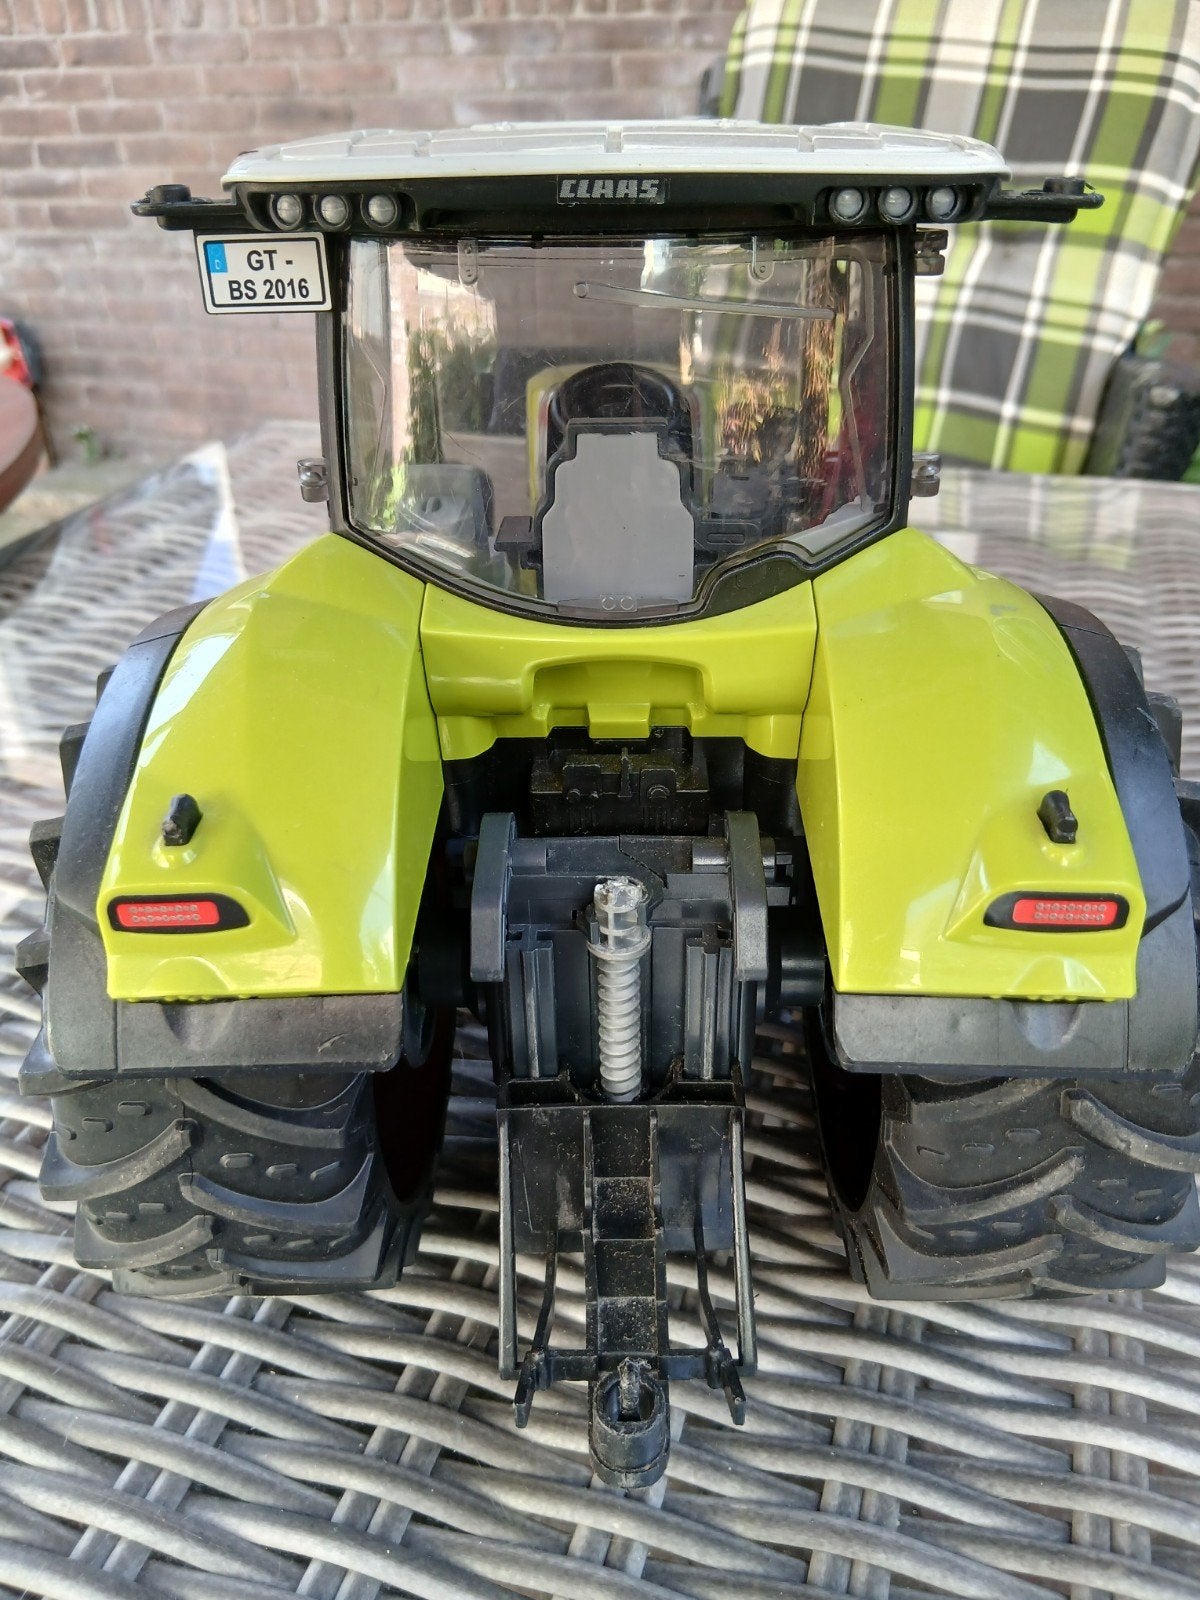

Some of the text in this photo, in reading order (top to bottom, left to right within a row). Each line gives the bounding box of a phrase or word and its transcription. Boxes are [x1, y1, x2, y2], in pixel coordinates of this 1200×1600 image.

[559, 179, 660, 199] CLAAS
[246, 249, 278, 271] GT
[228, 278, 310, 300] BS 2016
